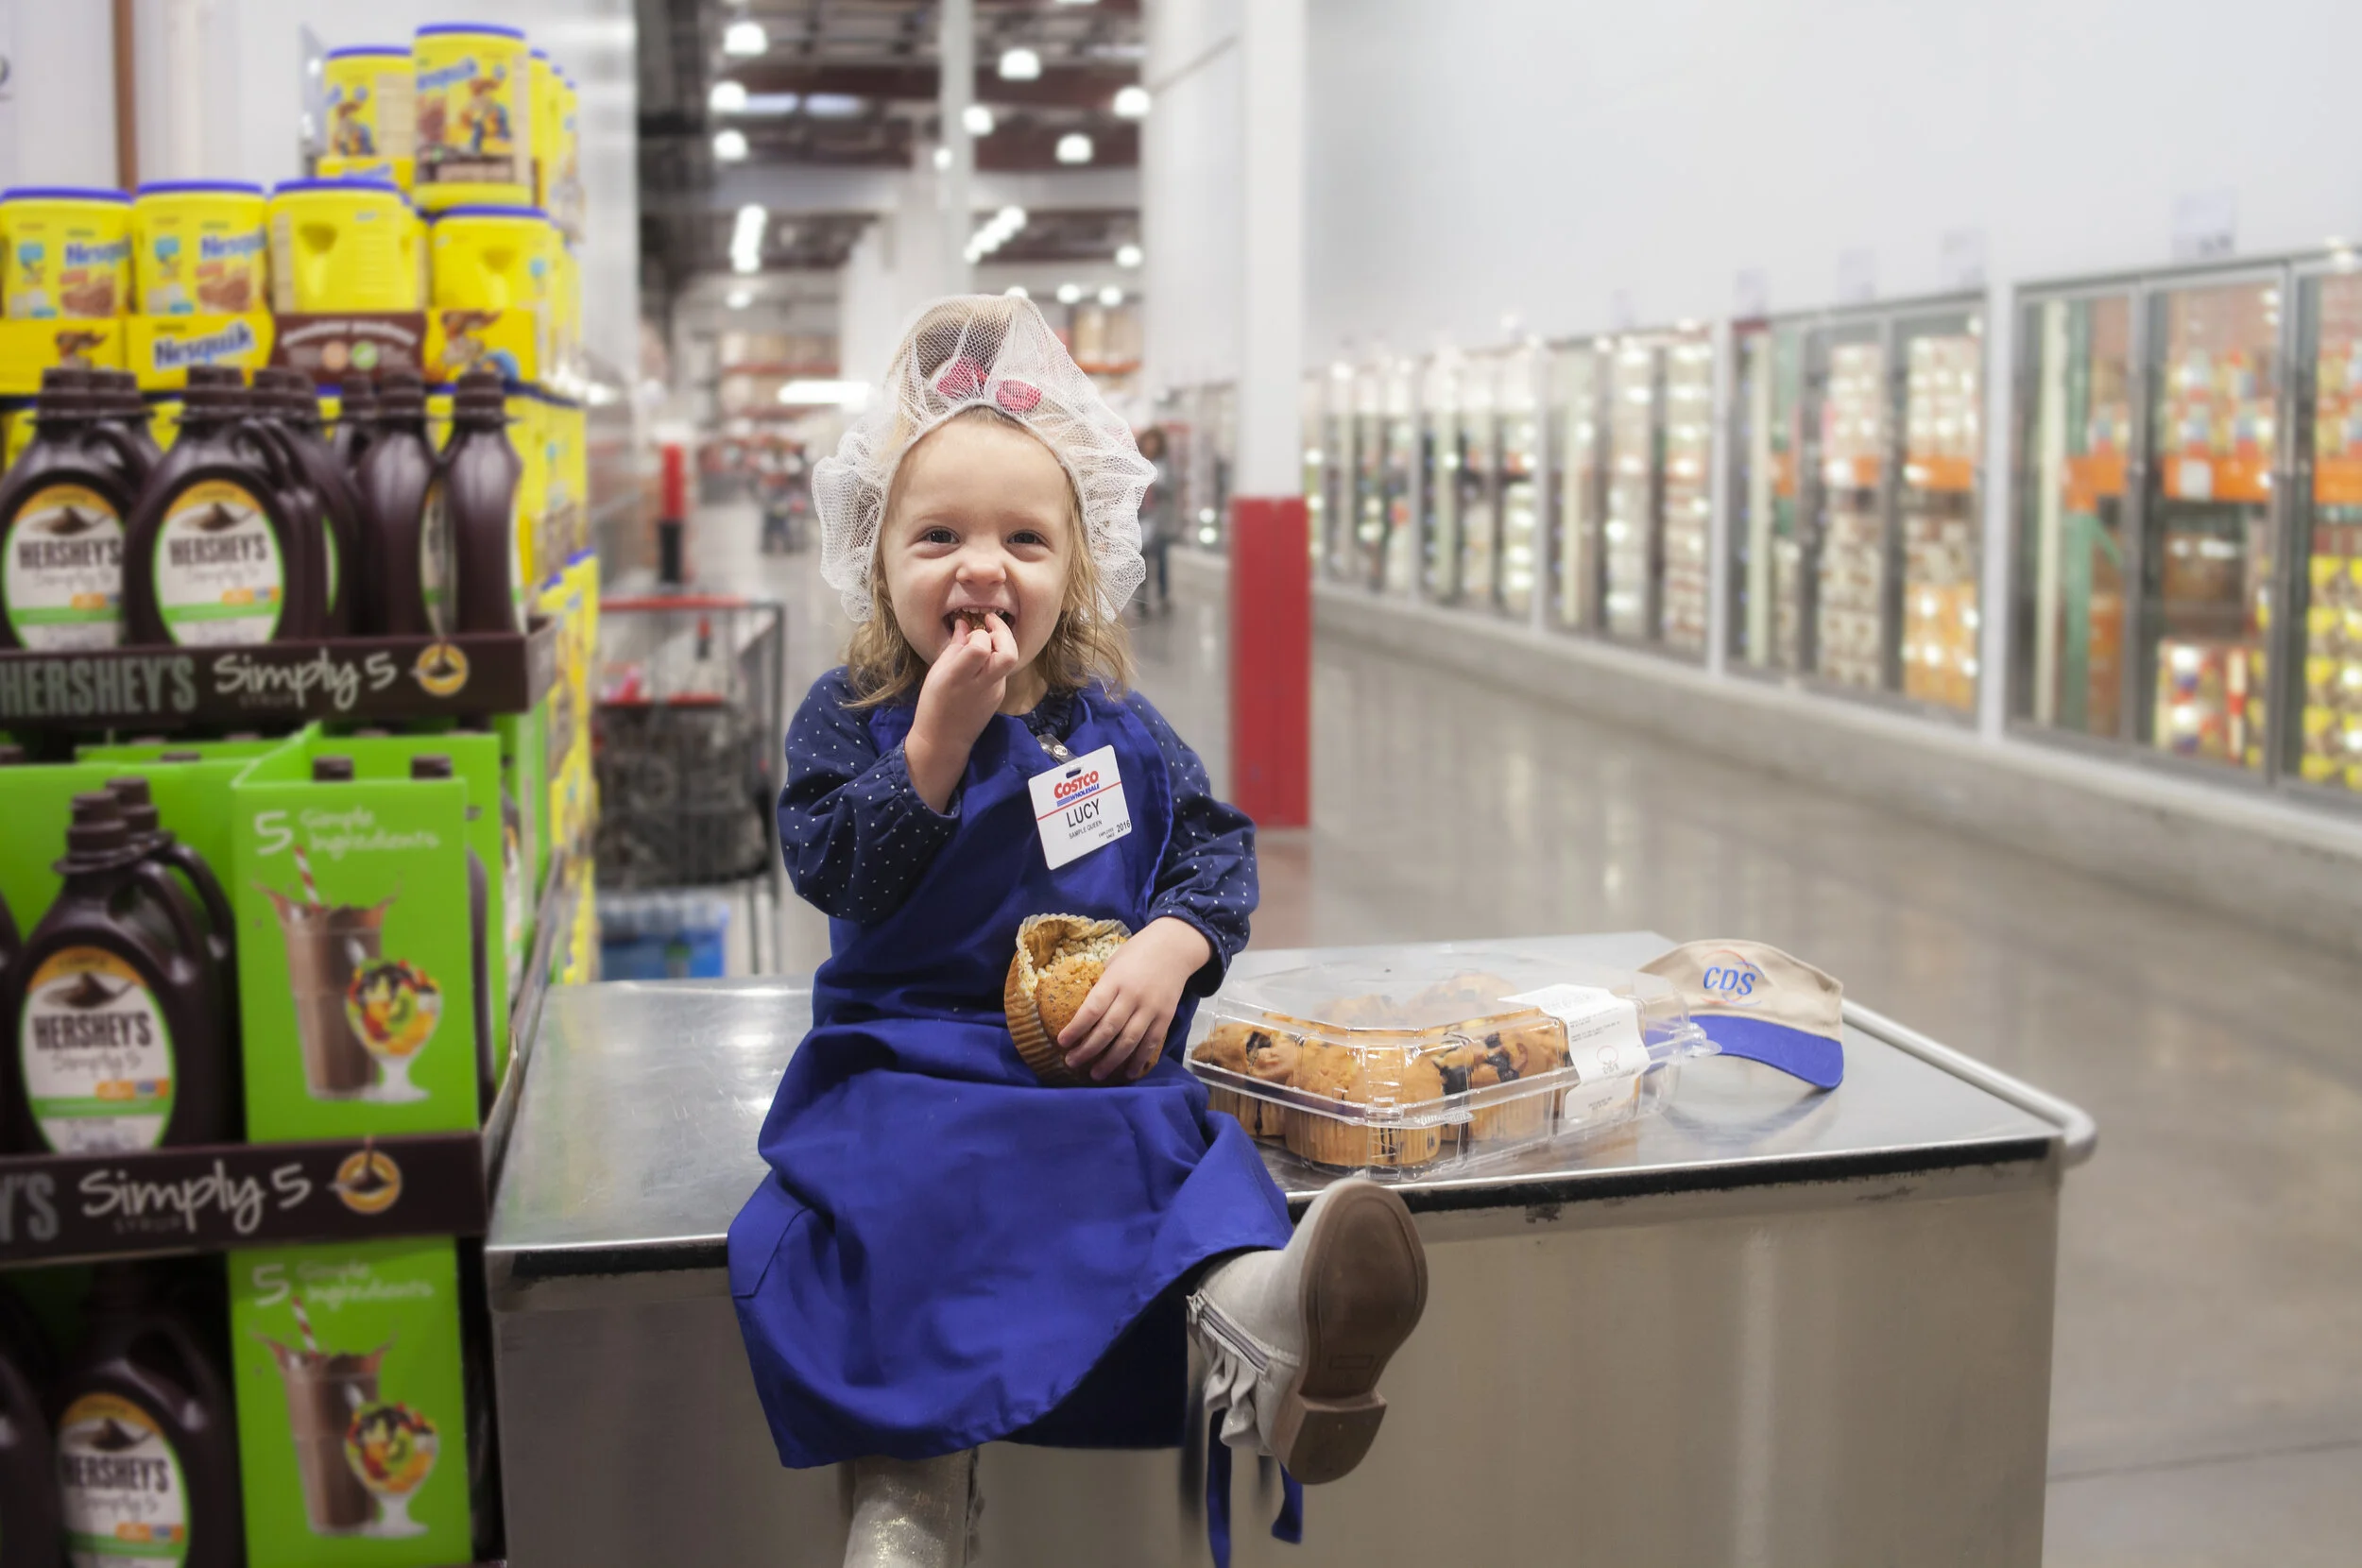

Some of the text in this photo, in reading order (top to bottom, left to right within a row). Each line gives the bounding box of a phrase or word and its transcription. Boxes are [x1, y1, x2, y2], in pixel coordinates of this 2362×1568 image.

[154, 322, 252, 369] Nesquik
[169, 533, 267, 568] HERSHEY'S
[214, 647, 397, 710] Simply 5
[1054, 771, 1099, 798] COSTCO
[1069, 783, 1100, 801] WHOLESALE
[1066, 798, 1101, 827] LUCY
[1069, 820, 1103, 840] SAMPLE QUEEN
[1116, 820, 1131, 833] 2016
[253, 810, 293, 856] 5
[1703, 965, 1756, 996] CDS
[34, 1011, 152, 1049] HERSHEY'S
[78, 1159, 312, 1234] Simply 5
[252, 1263, 290, 1307] 5
